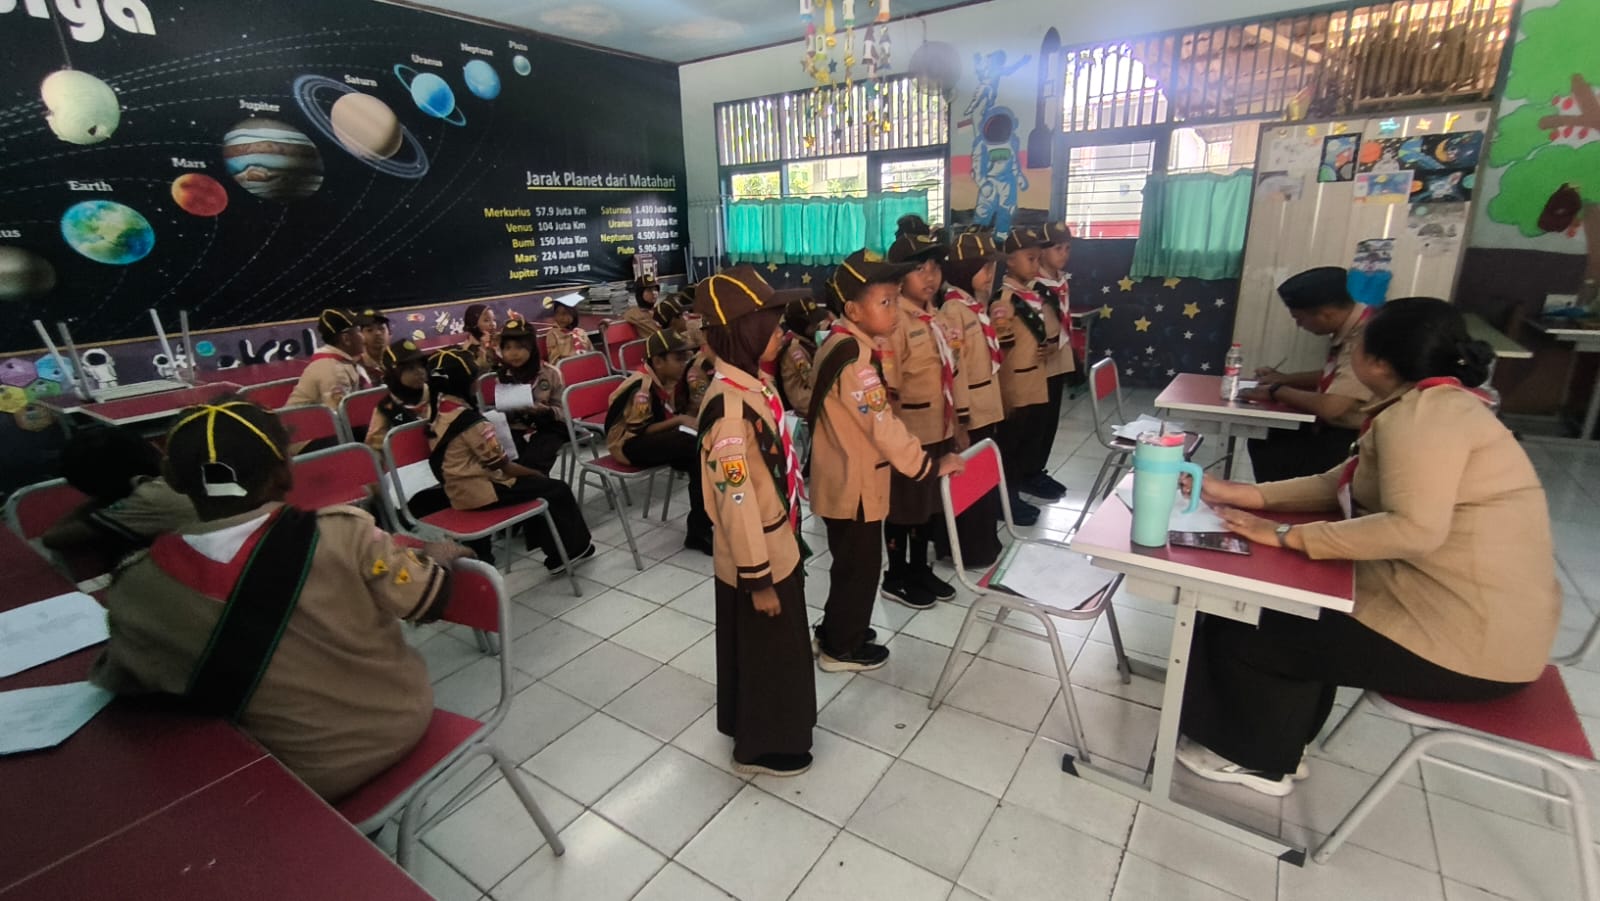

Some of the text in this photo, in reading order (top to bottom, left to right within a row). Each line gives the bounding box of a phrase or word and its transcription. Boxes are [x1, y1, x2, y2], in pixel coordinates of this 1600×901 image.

[344, 74, 377, 87] Saturn
[239, 99, 280, 112] Jupiter
[171, 157, 206, 169] Mars
[526, 171, 676, 188] Jarak Planet dari Matahari
[67, 180, 113, 192] Earth
[484, 206, 587, 218] Merkurius 57.9 Juta Km
[601, 206, 632, 216] Saturnus
[506, 221, 586, 233] Venus 104 Juta Km
[608, 220, 633, 229] Uranus
[0, 229, 21, 238] us
[512, 235, 588, 249] Bumi 150 Juta Km
[514, 249, 589, 264] Mars 224 Juta Km
[617, 246, 636, 255] Pluto
[509, 264, 591, 280] Jupiter 779 Juta Km
